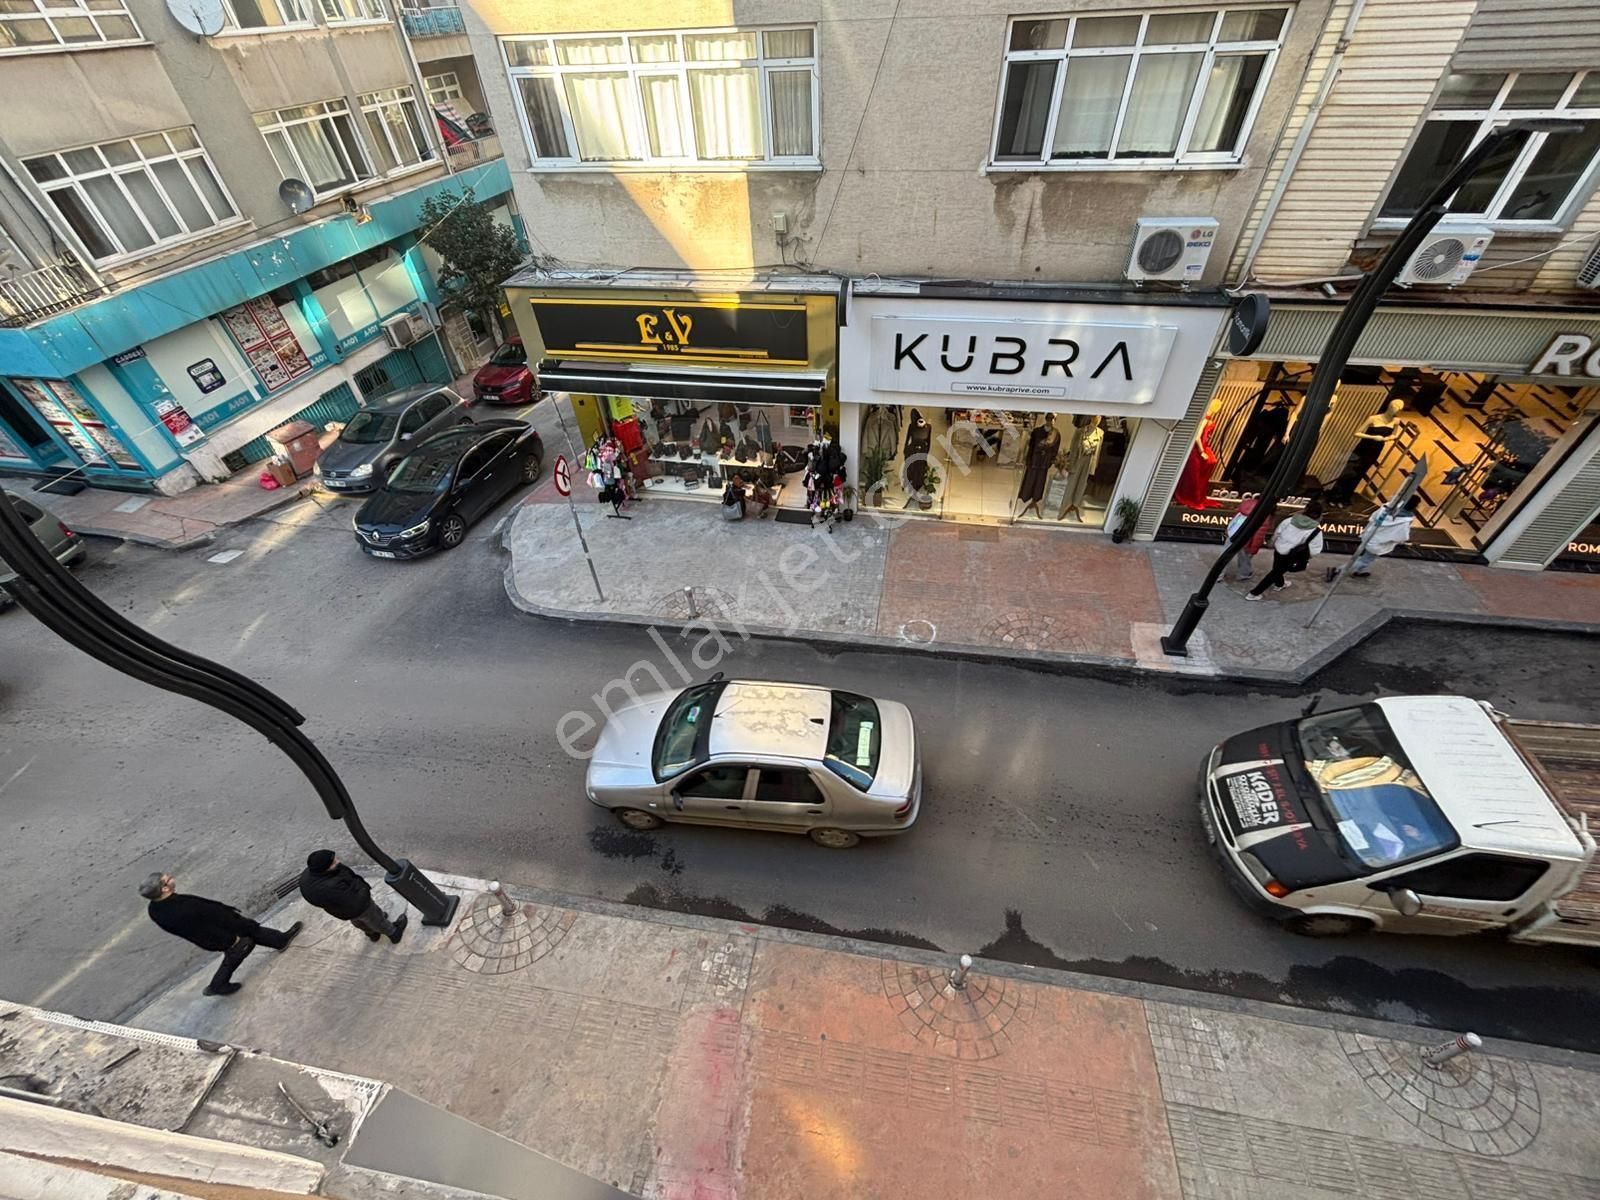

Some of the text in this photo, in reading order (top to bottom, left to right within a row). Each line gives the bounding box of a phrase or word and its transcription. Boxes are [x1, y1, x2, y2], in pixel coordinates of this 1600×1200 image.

[894, 333, 1133, 380] KUBRA
[966, 385, 1050, 394] www.kubraprive.com
[1246, 771, 1280, 825] KADER
